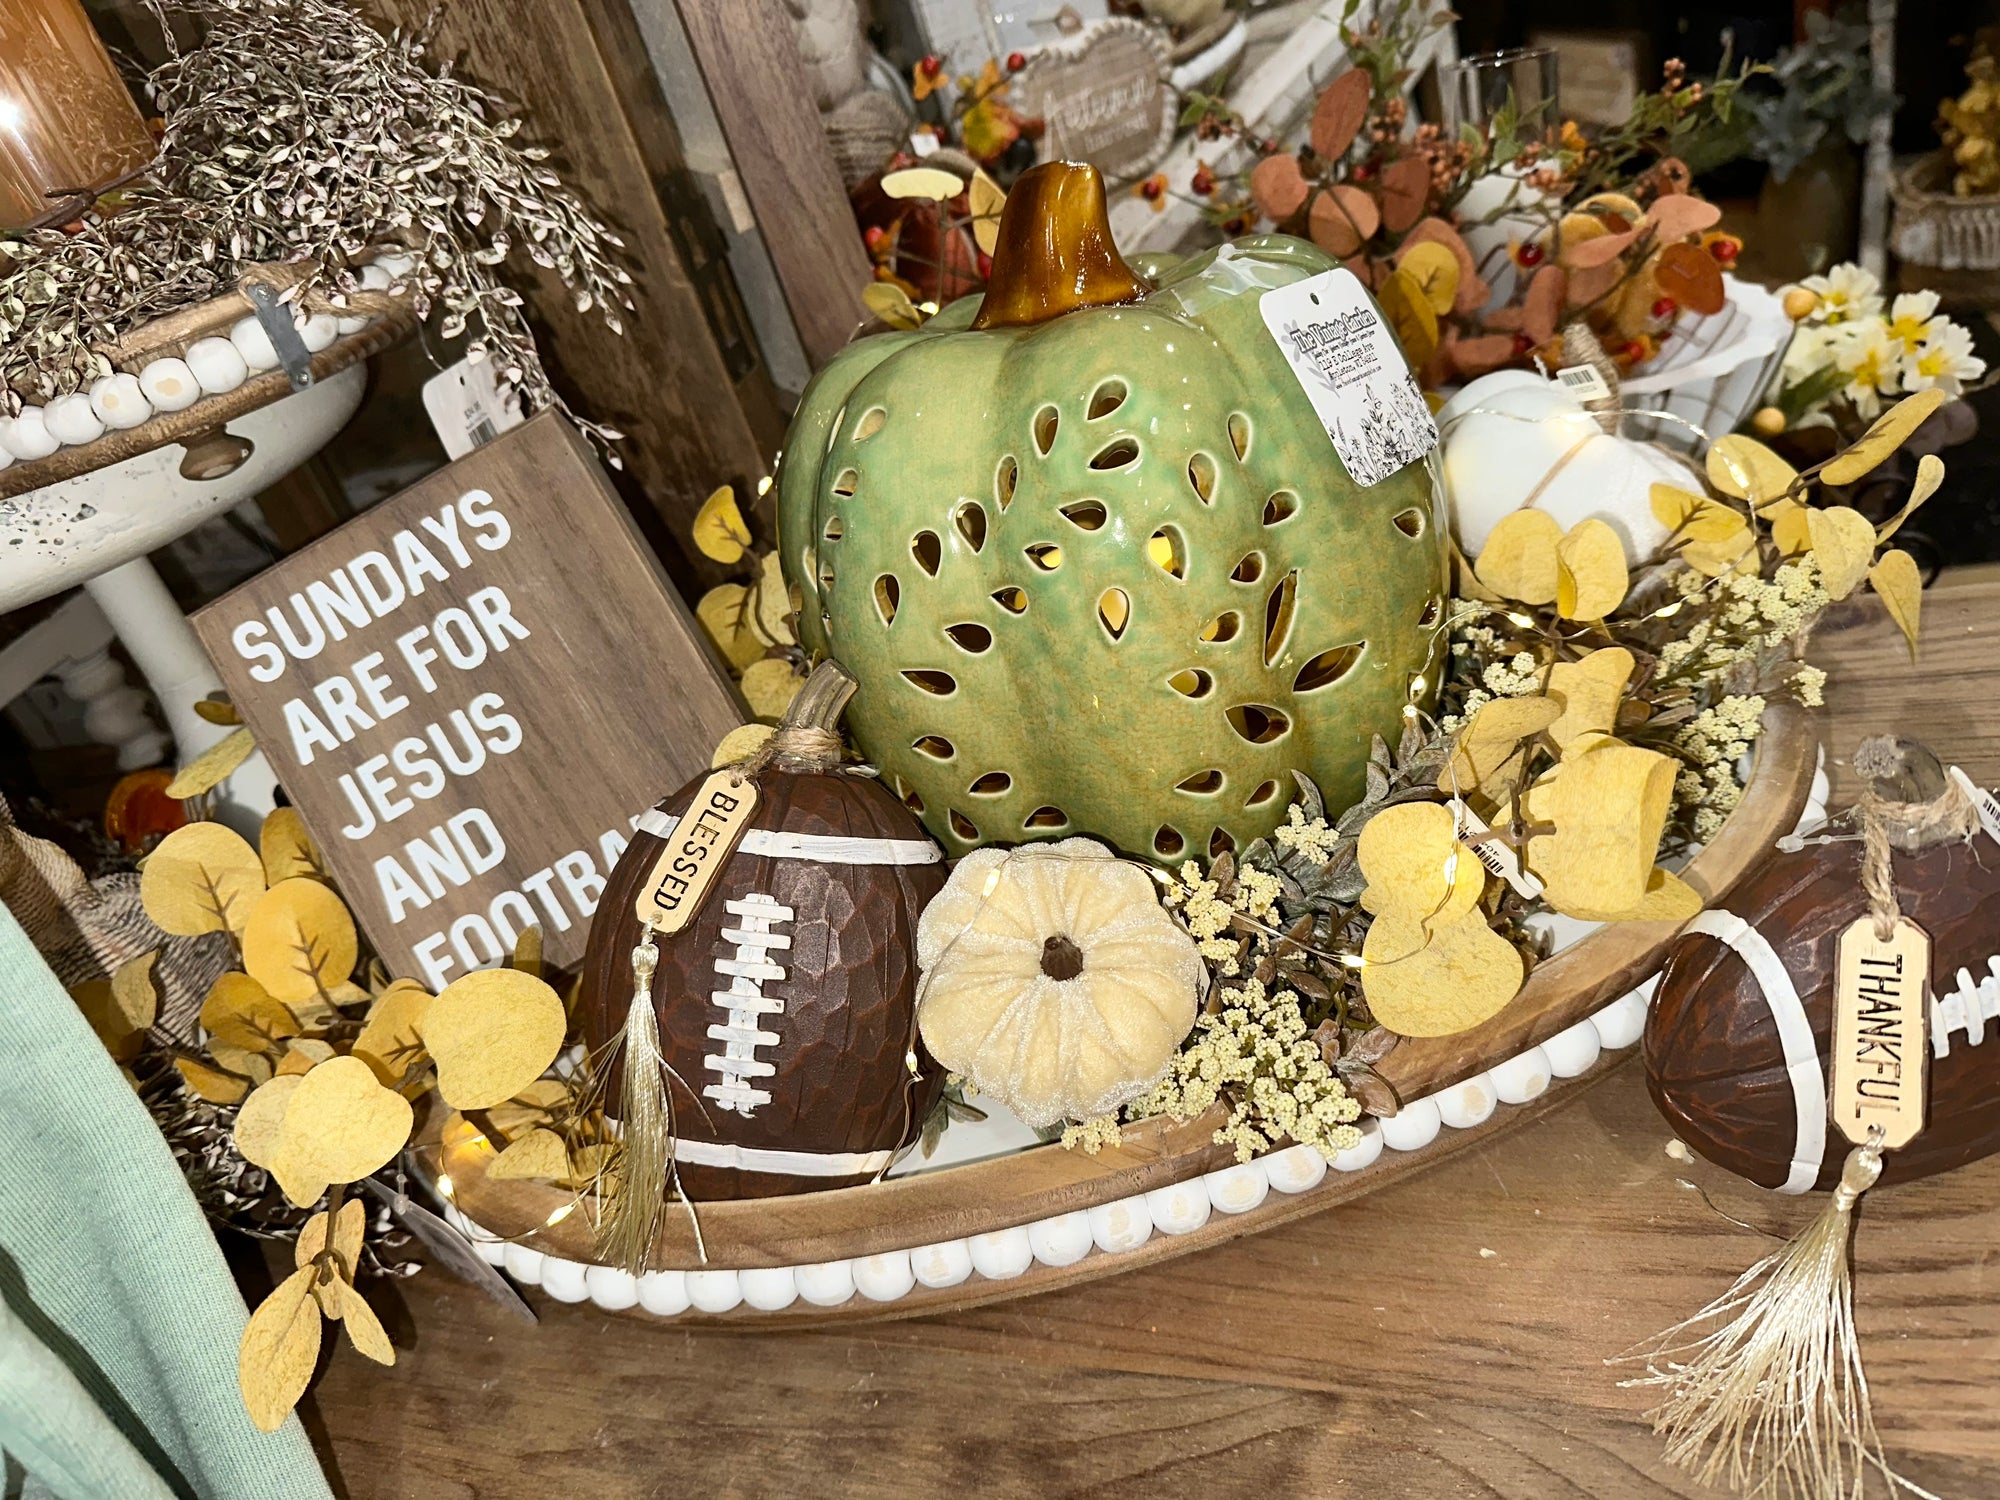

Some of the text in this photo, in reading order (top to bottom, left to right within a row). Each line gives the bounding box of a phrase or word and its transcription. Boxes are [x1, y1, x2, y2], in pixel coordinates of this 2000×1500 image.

[1290, 329, 1318, 354] The
[1308, 319, 1348, 347] Vintage
[1341, 306, 1377, 334] Garden
[1319, 343, 1375, 370] 119 E College Ave
[232, 489, 511, 682] SUNDAYS
[283, 586, 531, 766] ARE FOR
[338, 692, 523, 840] JESUS
[373, 808, 506, 924] AND
[413, 814, 641, 994] FOOTBA
[653, 791, 740, 910] BLESSED
[1856, 954, 1903, 1119] THANKFUL
